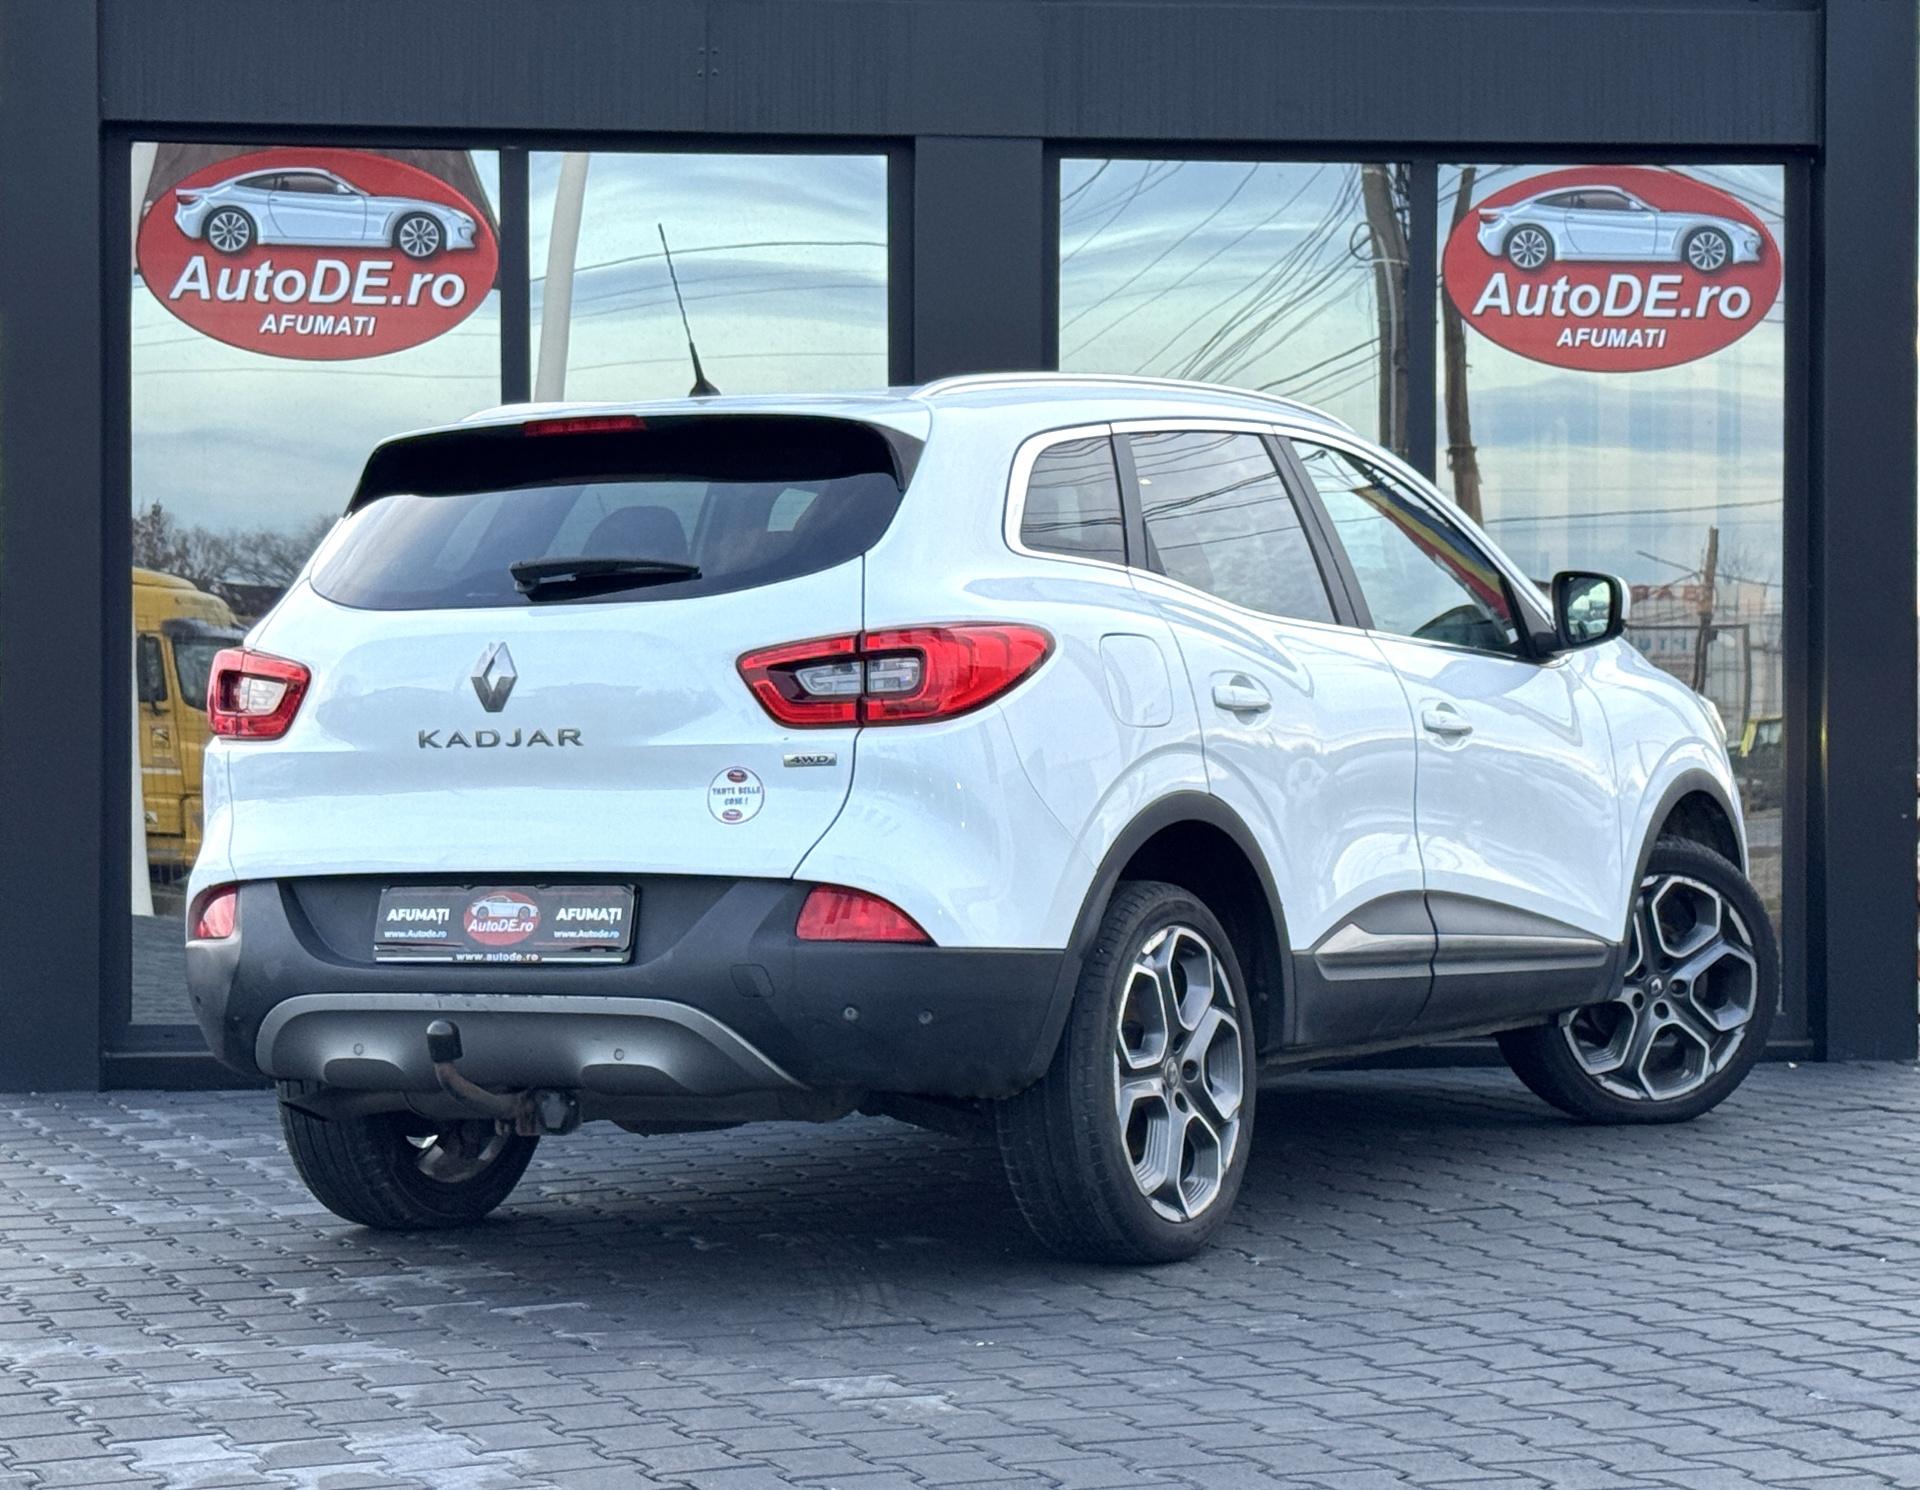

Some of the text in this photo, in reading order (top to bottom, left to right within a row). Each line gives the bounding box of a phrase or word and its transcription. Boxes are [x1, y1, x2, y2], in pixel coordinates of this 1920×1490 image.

[169, 255, 467, 308] AutoDE.ro
[1471, 272, 1752, 319] AutoDE.ro
[259, 313, 377, 337] AFUMATI
[1556, 328, 1667, 349] AFUMATI
[418, 727, 584, 750] KADJAR
[789, 755, 829, 764] 4WD
[467, 918, 534, 932] AutoDE.ro
[455, 952, 539, 962] www.autode.ro
